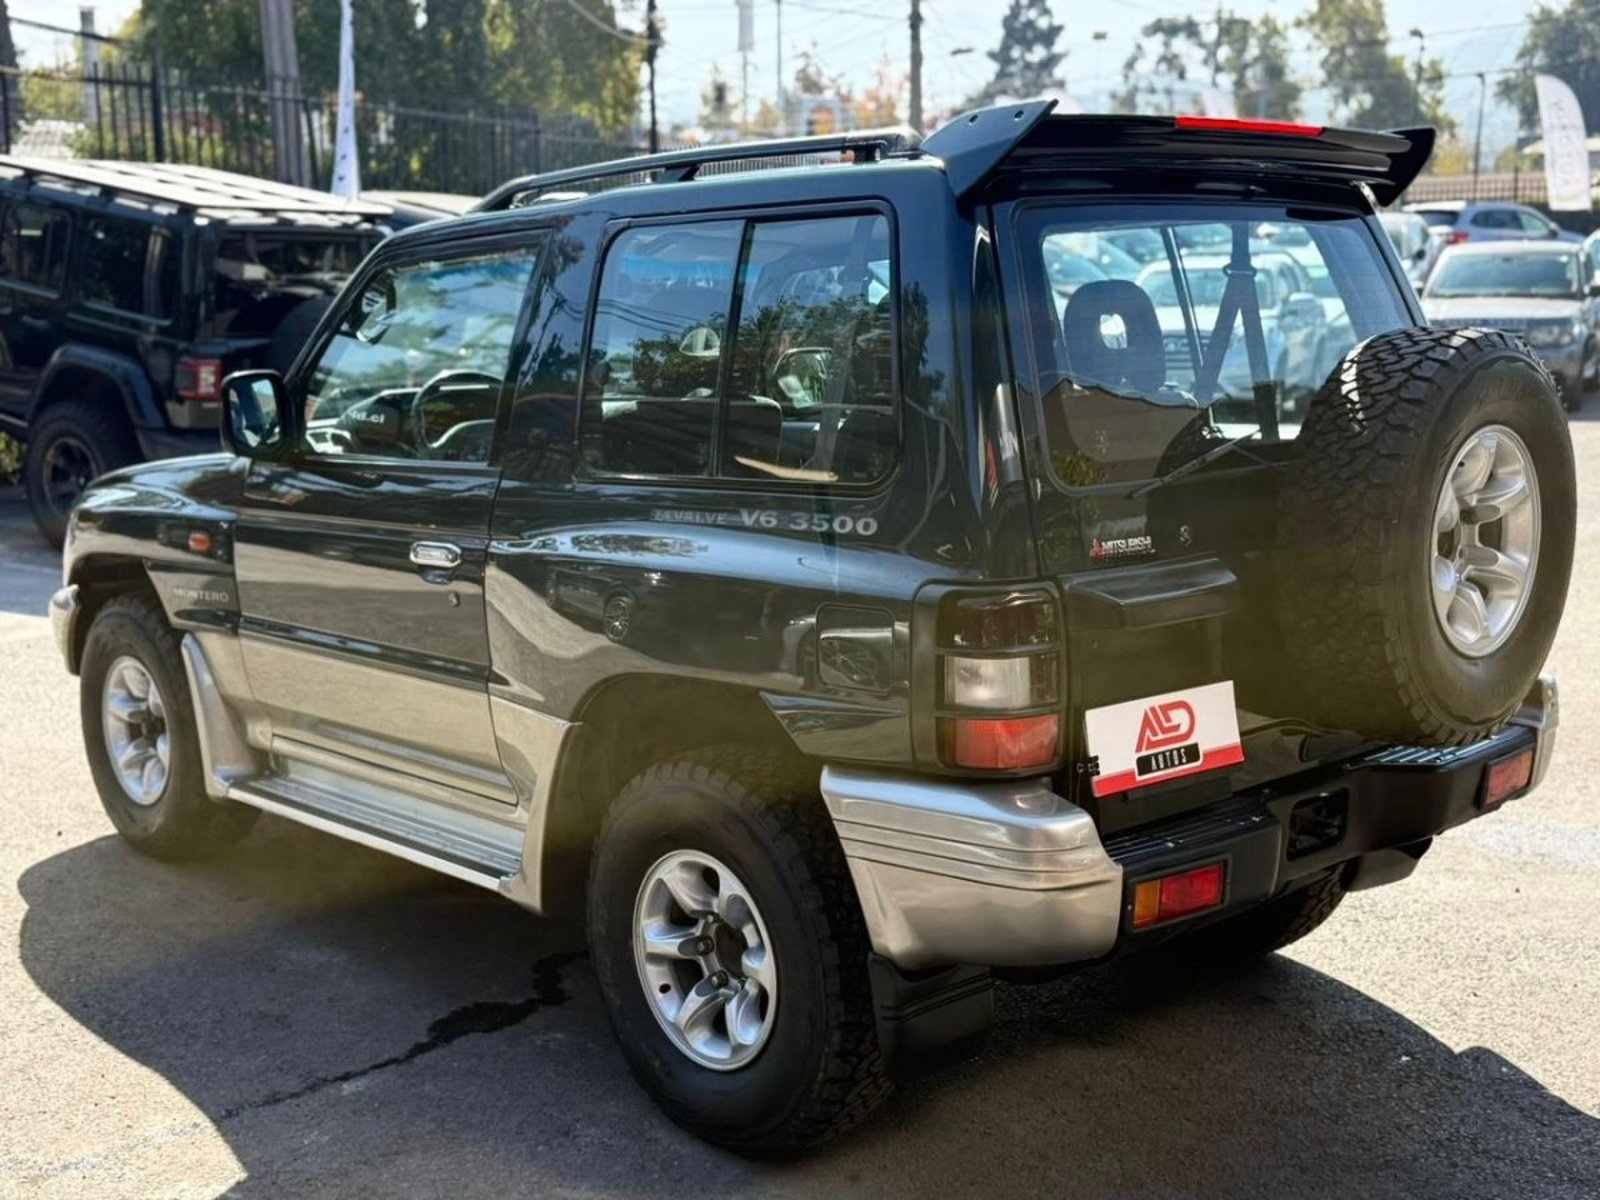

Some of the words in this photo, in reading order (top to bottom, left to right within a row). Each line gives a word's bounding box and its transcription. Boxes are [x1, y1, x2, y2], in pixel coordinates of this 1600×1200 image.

[738, 508, 778, 528] V6
[788, 512, 878, 536] 3500
[172, 586, 230, 603] MONTERO
[1150, 748, 1188, 771] AUTOS
